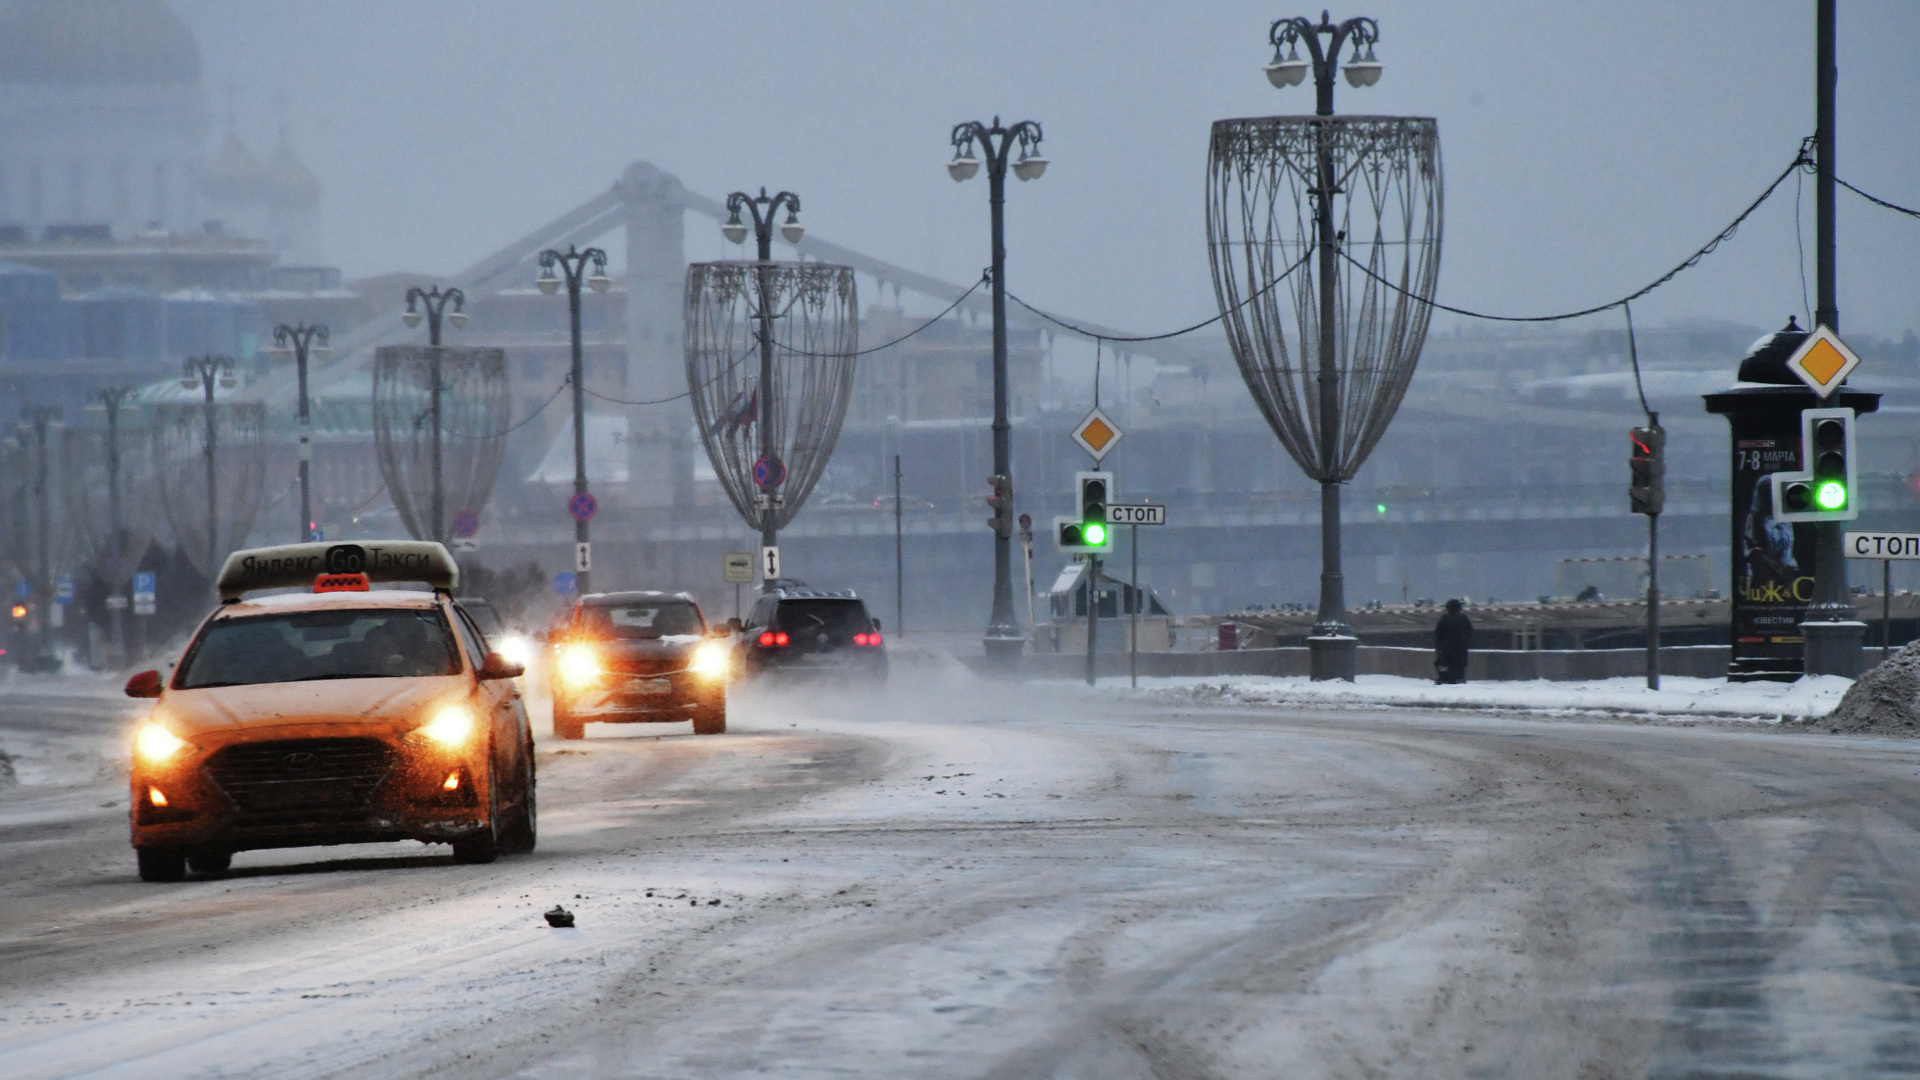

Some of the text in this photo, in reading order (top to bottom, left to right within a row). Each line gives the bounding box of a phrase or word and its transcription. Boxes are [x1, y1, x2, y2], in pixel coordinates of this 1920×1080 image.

[1738, 450, 1761, 470] 7-8
[1763, 451, 1795, 462] МАРТА
[1113, 508, 1156, 521] СТОП
[1856, 536, 1919, 555] СТОП
[242, 548, 430, 576] Яндекс Go Такси
